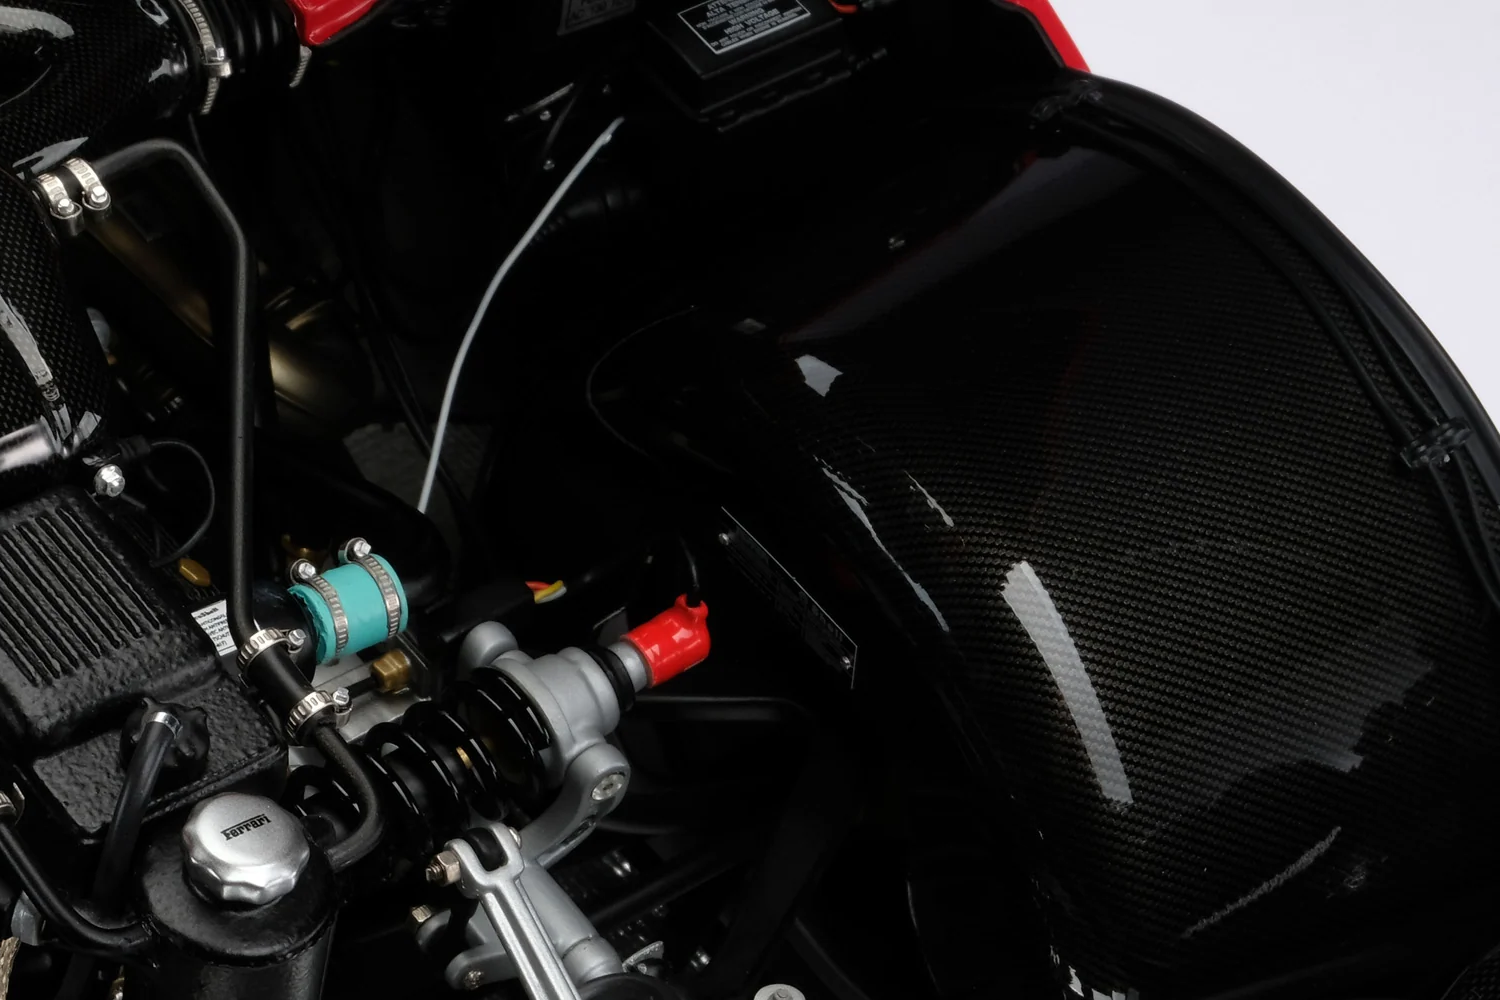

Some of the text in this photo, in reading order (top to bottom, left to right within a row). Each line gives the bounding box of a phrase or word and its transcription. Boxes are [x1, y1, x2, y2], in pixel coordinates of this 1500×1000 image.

[728, 8, 766, 25] WARNING
[744, 8, 781, 25] VOLTAGE
[220, 813, 272, 841] Ferrari
